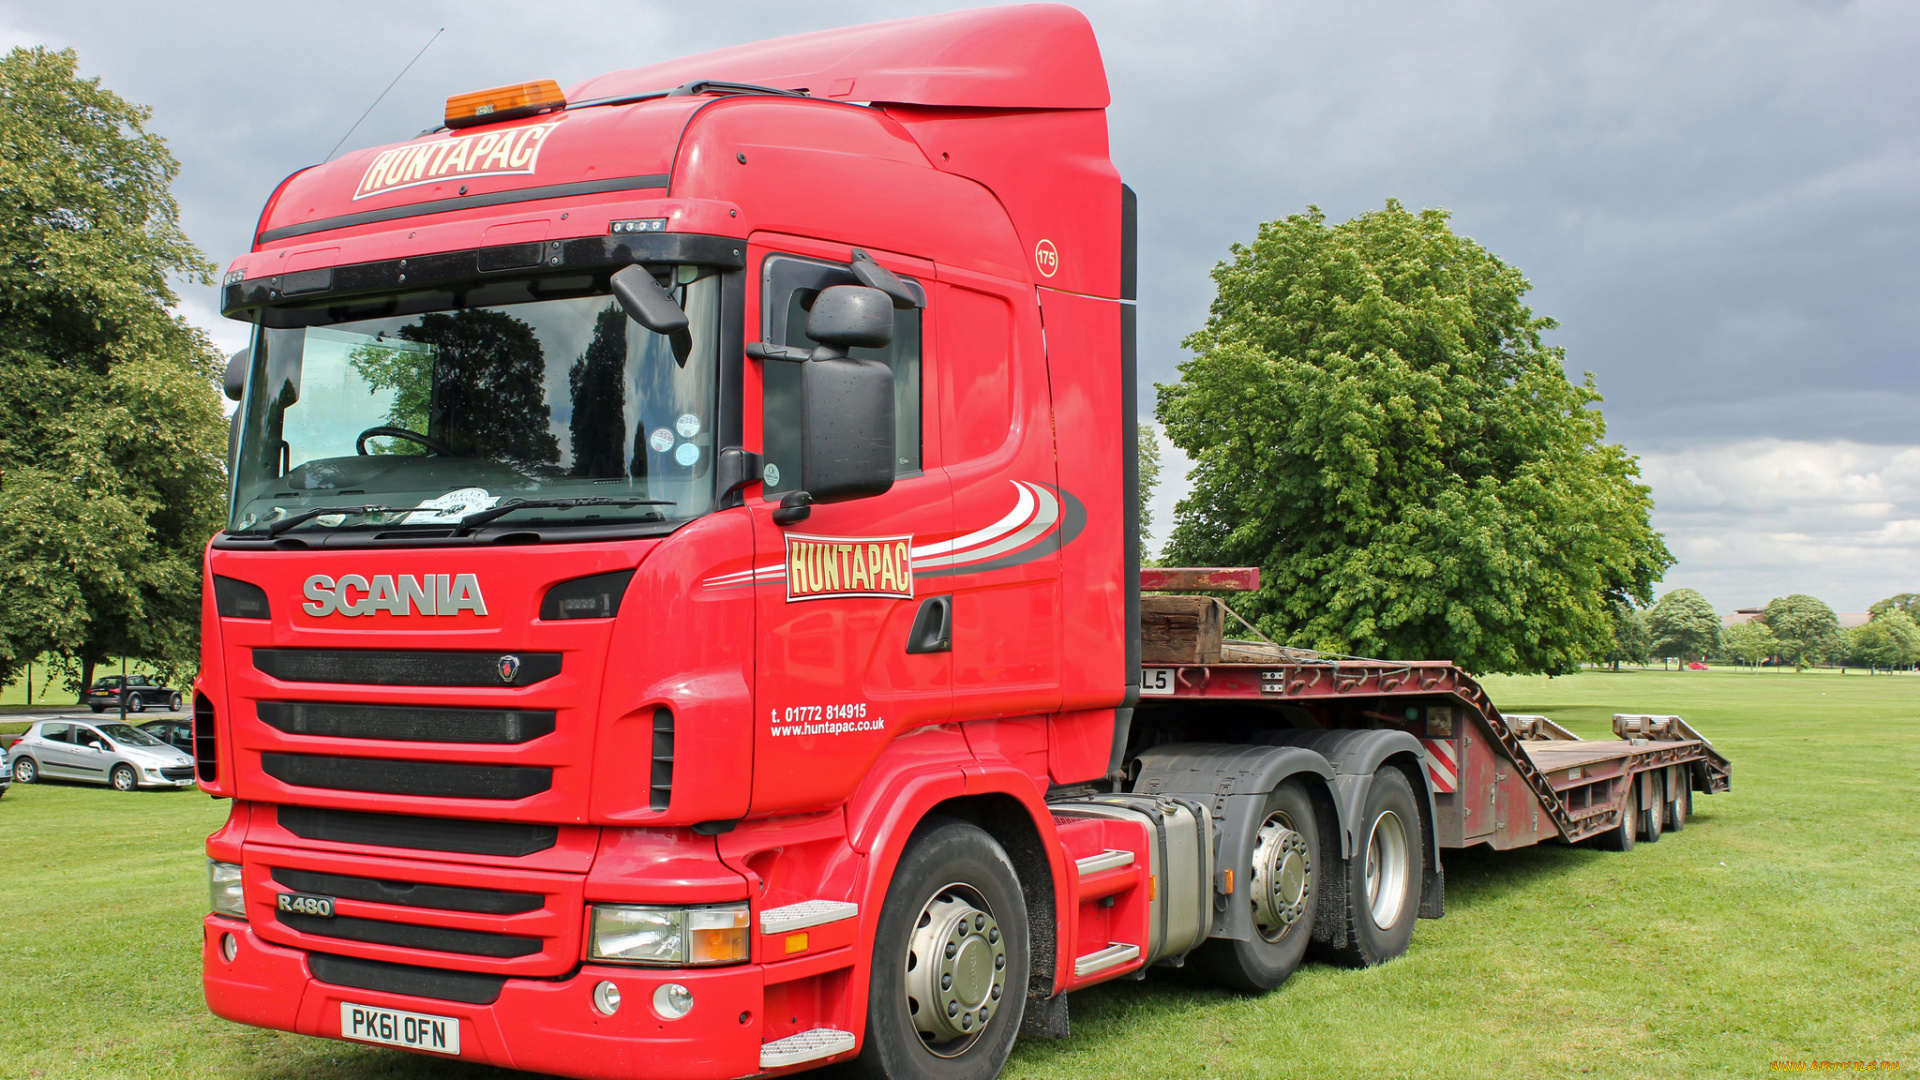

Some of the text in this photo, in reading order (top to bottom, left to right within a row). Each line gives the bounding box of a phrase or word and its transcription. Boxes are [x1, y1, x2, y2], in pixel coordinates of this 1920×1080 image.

[364, 126, 545, 191] HUNTAPAC
[1038, 249, 1055, 266] 175
[791, 541, 909, 594] HUNTAPAC
[302, 573, 488, 617] SCANIA
[1138, 670, 1167, 690] L5
[771, 703, 867, 723] t. 01772 814915
[771, 717, 885, 737] www.huntapac.co.uk
[353, 1009, 446, 1048] PK61 OFN
